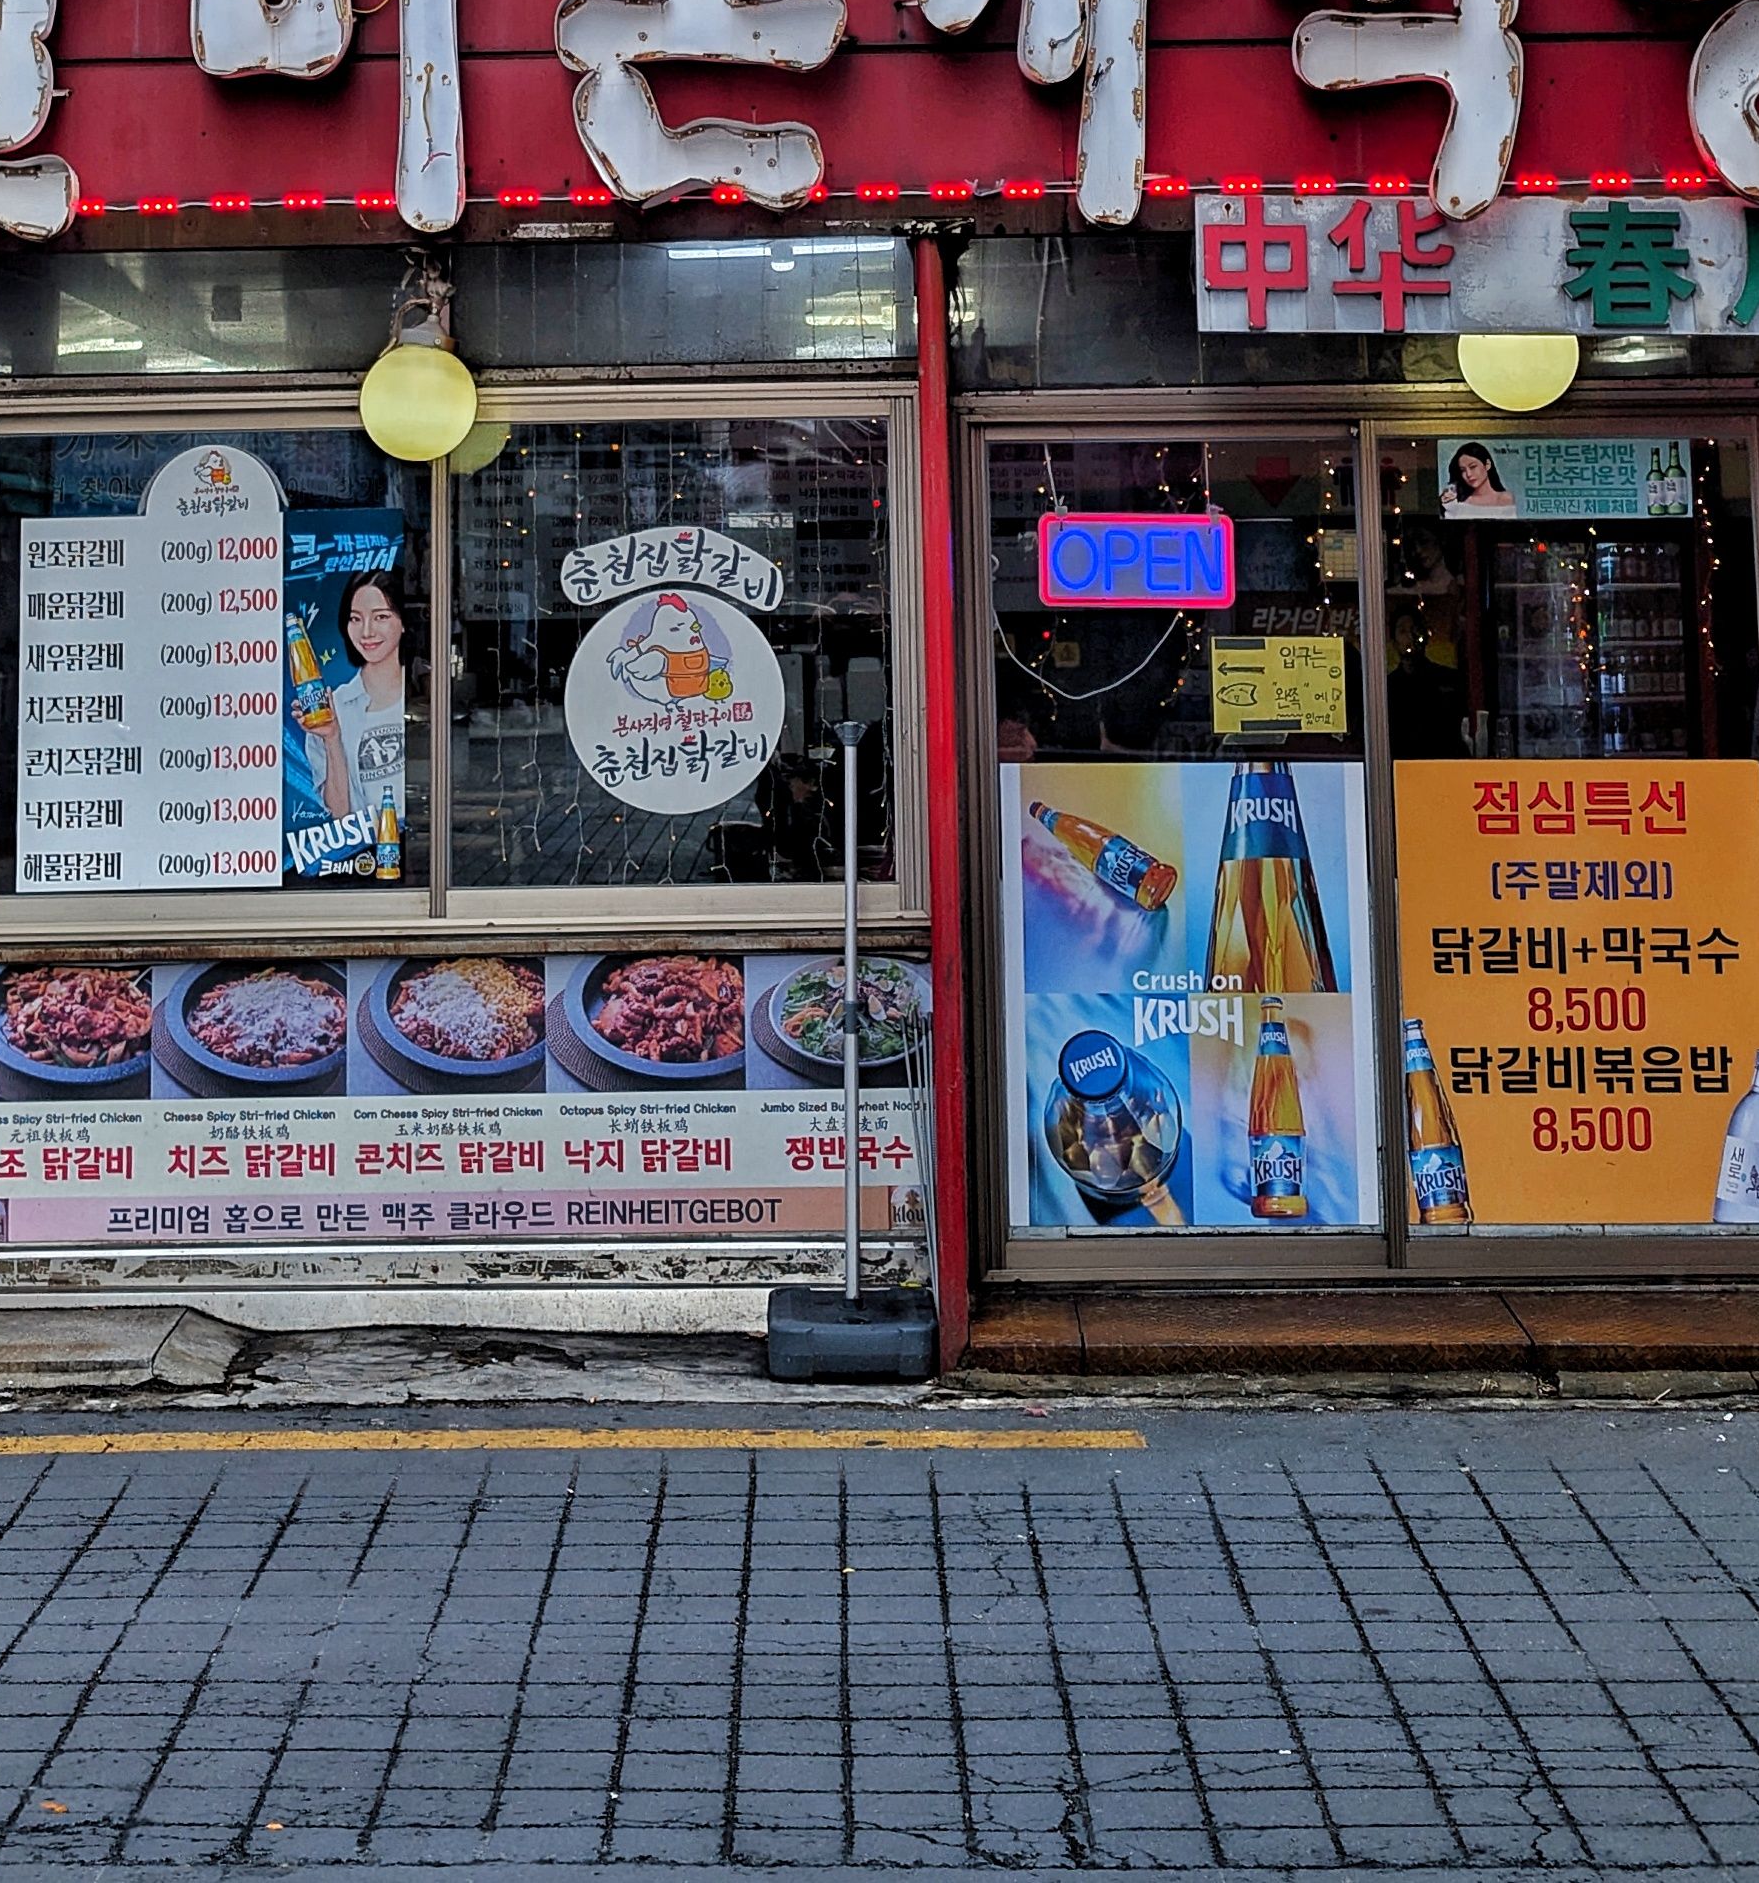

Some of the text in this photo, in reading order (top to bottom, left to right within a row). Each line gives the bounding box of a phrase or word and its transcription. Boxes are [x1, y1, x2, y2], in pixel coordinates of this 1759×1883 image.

[1545, 444, 1635, 464] 부드럽지만
[1545, 466, 1637, 486] 소주다운 맛
[1525, 499, 1582, 515] 새로워진
[26, 536, 279, 569] 원조닭갈비 (200g) 12,000
[564, 528, 783, 608] 춘천집닭갈비
[1052, 529, 1224, 592] OPEN
[27, 588, 279, 620] 매운닭갈비 (200g) 12,500
[25, 640, 279, 672] 새우닭갈비 (200g) 13,000
[1278, 645, 1327, 670] 입구는
[25, 692, 278, 724] 치즈닭갈비 (200g) 13,000
[613, 713, 673, 735] 본사직영
[25, 744, 278, 776] 콘치즈닭갈비 (200g) 13,000
[592, 729, 769, 789] 춘천집닭갈비
[24, 799, 124, 829] 낙지닭갈비
[159, 799, 211, 824] (200g)
[212, 796, 278, 822] 13,000
[1229, 797, 1299, 835] KRUSH
[1472, 779, 1689, 836] 점심특선
[286, 805, 380, 875] KRUSH
[23, 850, 278, 882] 해물닭갈비 (200g) 13,000
[1430, 925, 1742, 976] 닭갈비+막국수
[1131, 970, 1243, 993] Crush on
[1132, 995, 1245, 1048] KRUSH
[1527, 985, 1649, 1034] 8,500
[1068, 1046, 1117, 1084] KRUSH
[1448, 1045, 1735, 1096] 닭갈비볶음밥
[12, 1112, 43, 1127] Spicy
[96, 1111, 143, 1124] Chicken
[163, 1110, 205, 1123] Cheese
[206, 1109, 238, 1124] Spicy
[293, 1108, 337, 1121] Chicken
[502, 1106, 544, 1118] Chicken
[559, 1104, 605, 1118] Octopus
[607, 1103, 638, 1118] Spicy
[693, 1102, 738, 1115] Chicken
[760, 1100, 828, 1114] Jumbo Sized
[1532, 1105, 1654, 1155] 8,500
[42, 1145, 135, 1182] 닭갈비
[167, 1142, 337, 1180] 치즈 닭갈비
[354, 1140, 545, 1176] 콘치즈 닭갈비
[563, 1136, 733, 1173] 낙지 닭갈비
[1252, 1157, 1304, 1186] KRUSH
[1415, 1165, 1466, 1202] KRUSH
[106, 1197, 783, 1235] 프리미엄 홉으로 만든 맥주 클라우드 REINHEITGEBOT
